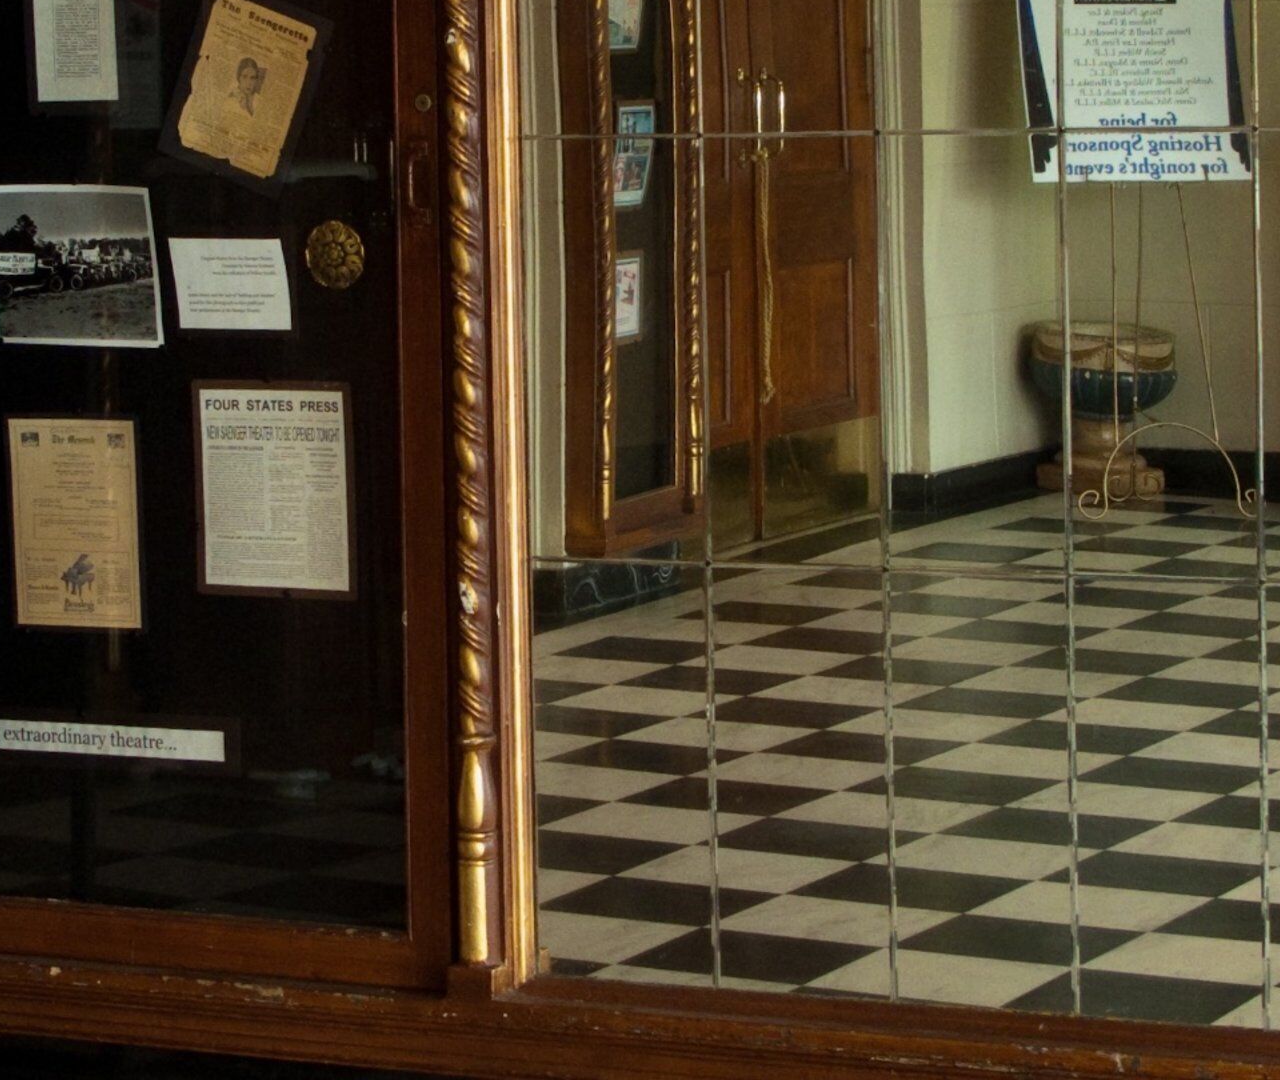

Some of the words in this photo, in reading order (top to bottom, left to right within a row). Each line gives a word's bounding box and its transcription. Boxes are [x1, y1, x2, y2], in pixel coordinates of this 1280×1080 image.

[221, 0, 242, 15] The
[205, 398, 240, 412] FOUR
[246, 399, 294, 413] STATES
[300, 400, 339, 414] PRESS
[3, 726, 107, 751] extraordinary
[109, 731, 178, 752] theatre...
